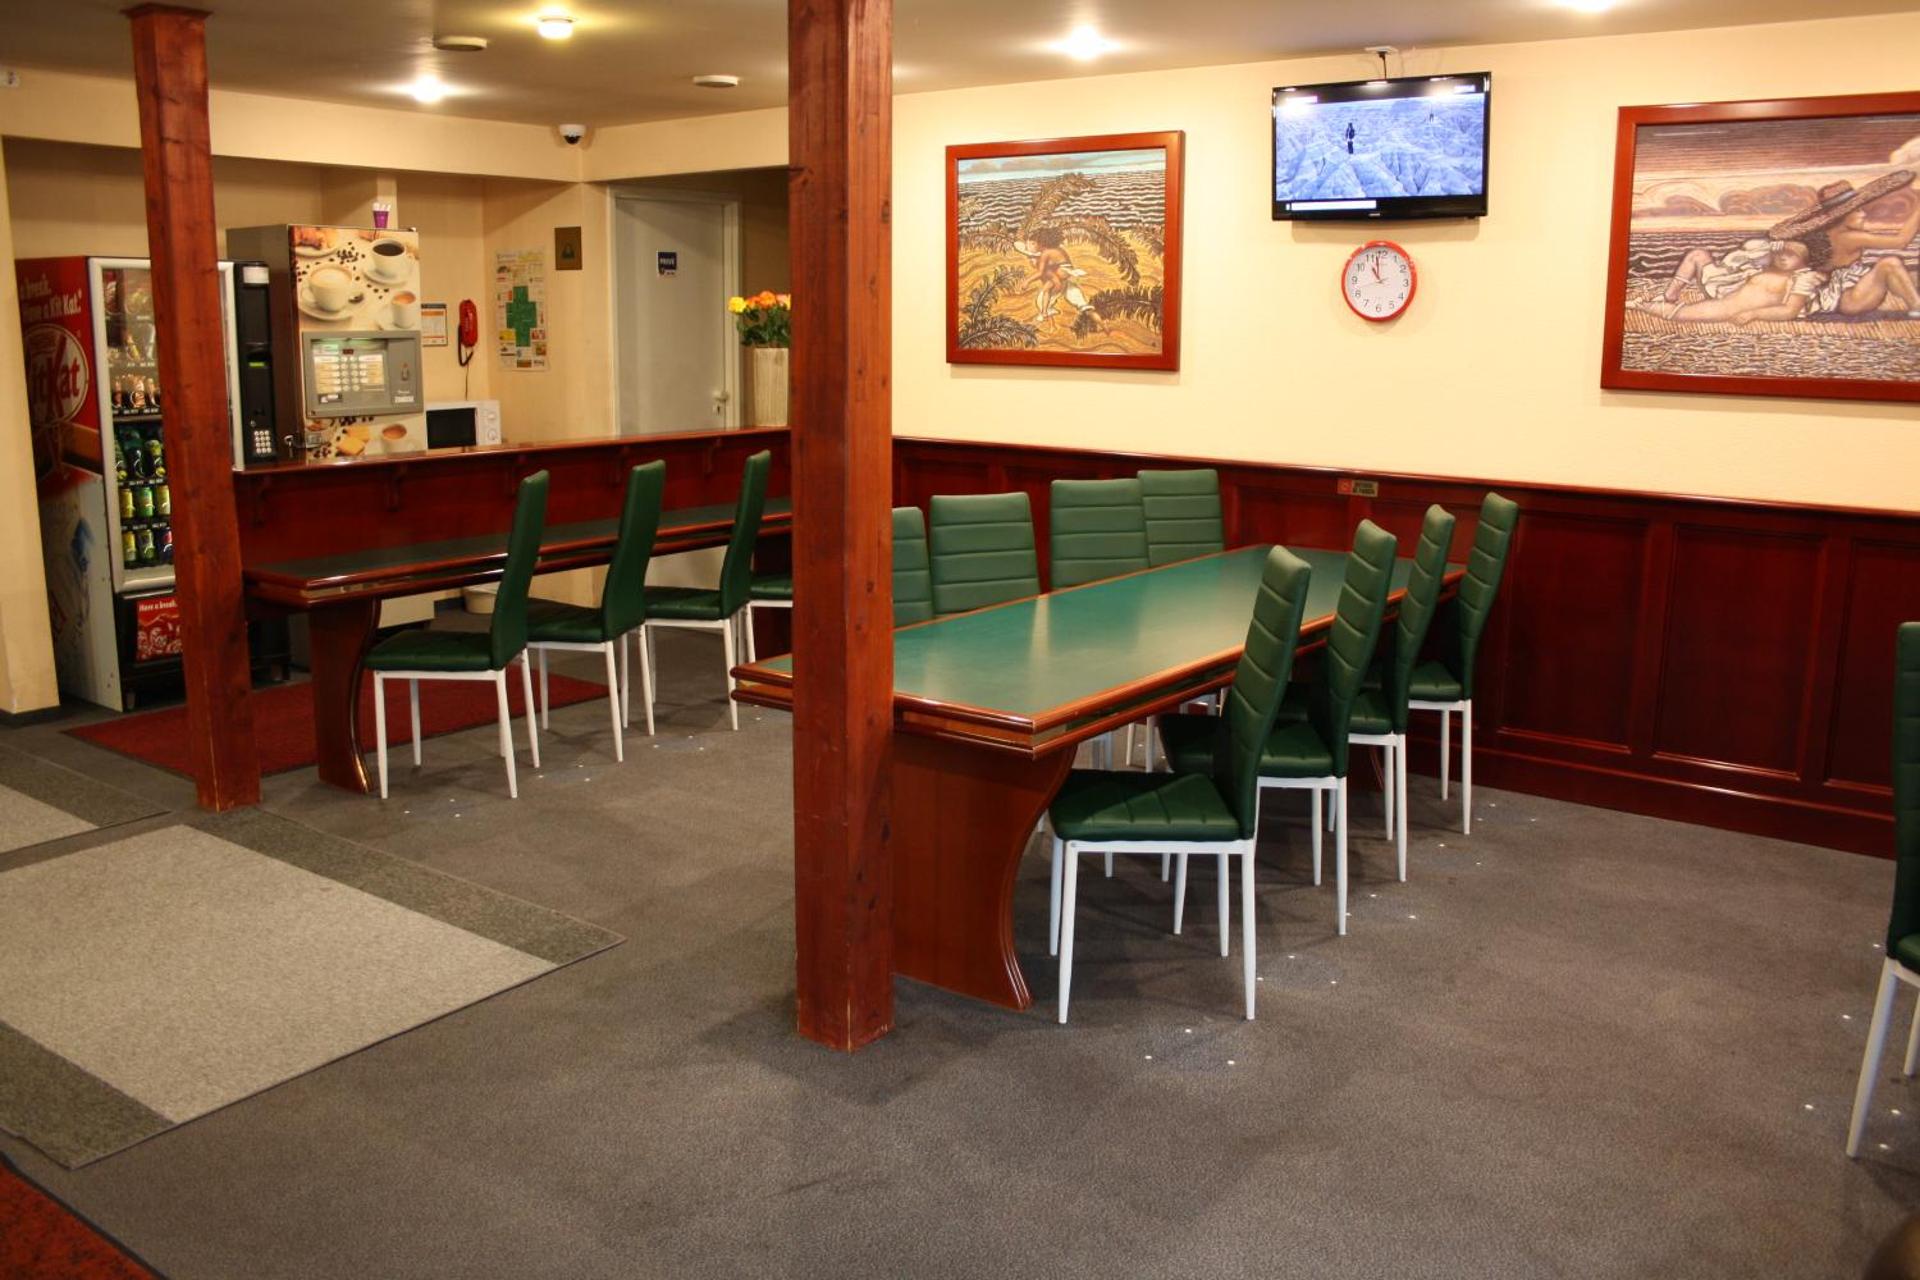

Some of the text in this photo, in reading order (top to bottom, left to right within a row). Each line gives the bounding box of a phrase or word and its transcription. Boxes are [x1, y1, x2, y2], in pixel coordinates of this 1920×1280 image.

[1366, 254, 1374, 262] 11
[1356, 263, 1365, 272] 10
[1400, 264, 1407, 273] 2
[1351, 276, 1358, 284] 9
[1403, 279, 1409, 287] 3
[1355, 290, 1361, 299] 8
[1397, 292, 1404, 300] 4
[1363, 299, 1369, 307] 7
[1389, 300, 1395, 309] 5
[1375, 304, 1381, 312] 6
